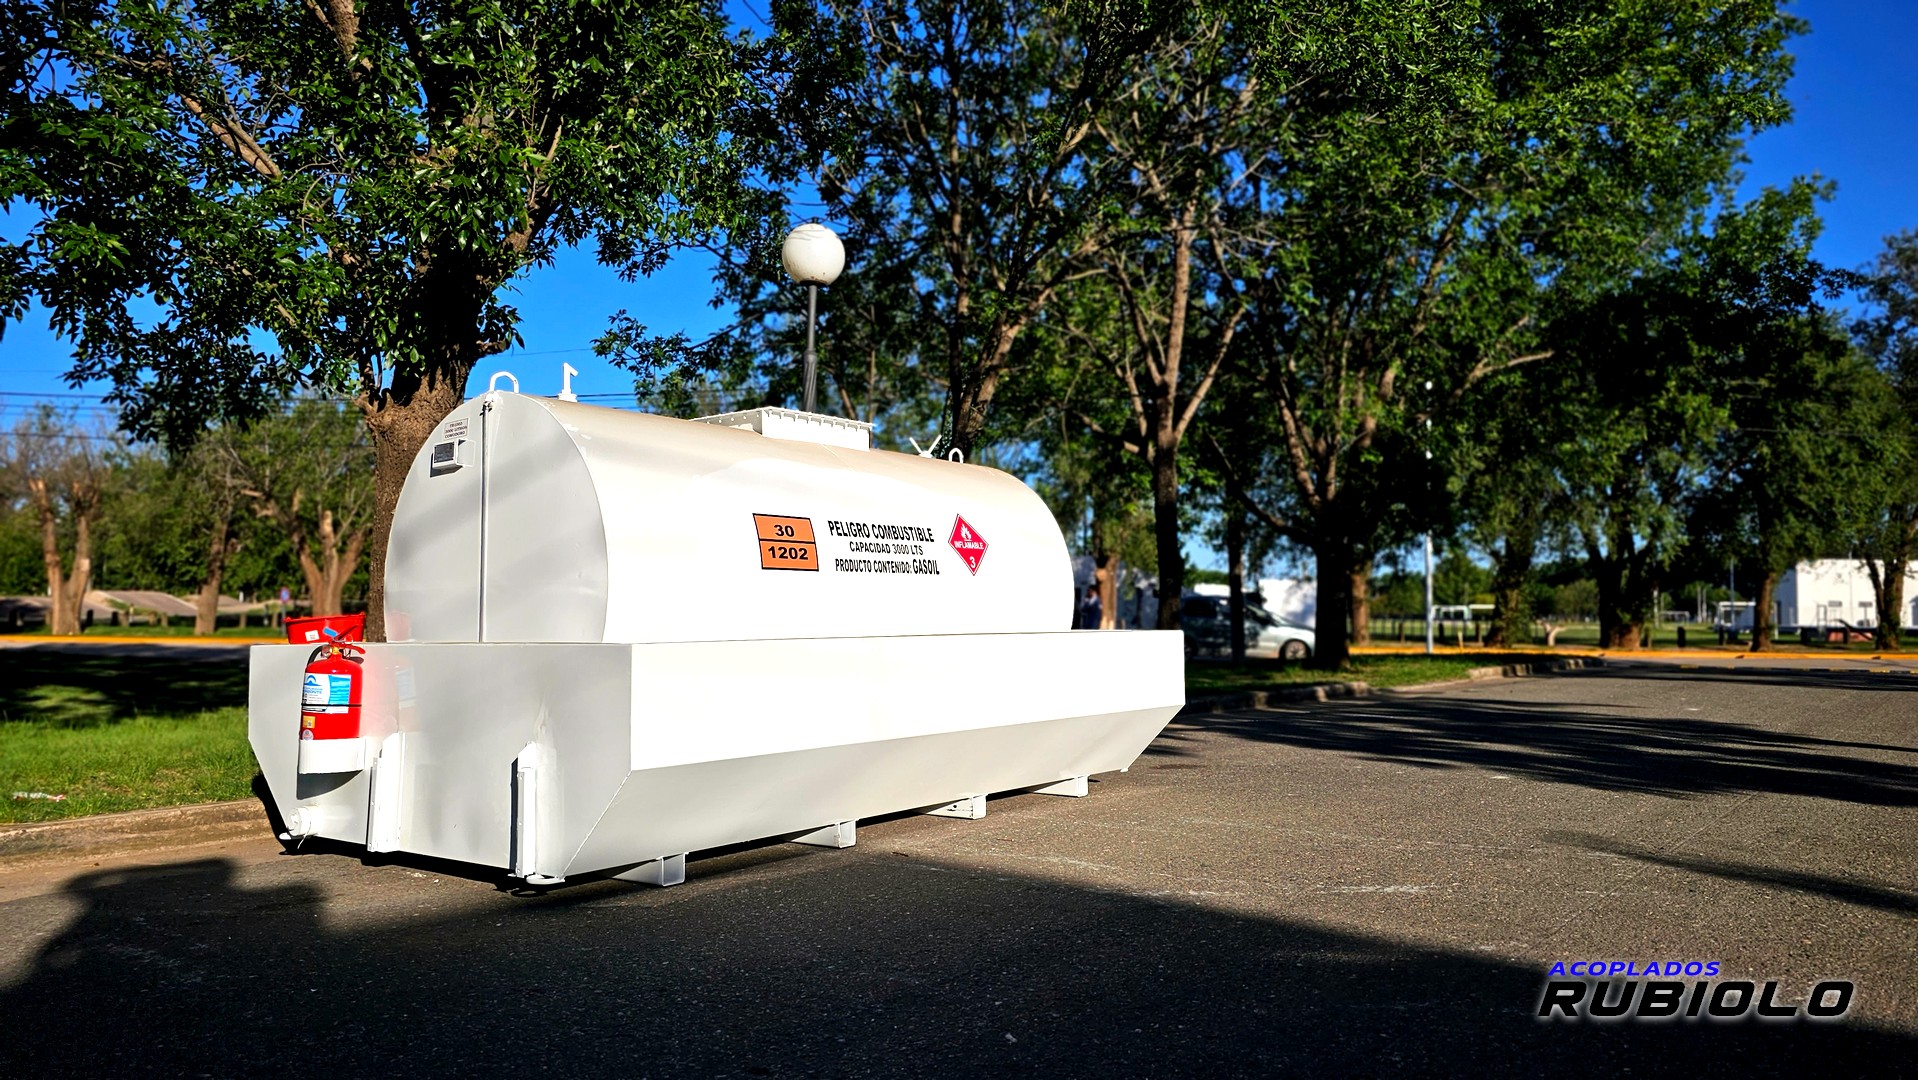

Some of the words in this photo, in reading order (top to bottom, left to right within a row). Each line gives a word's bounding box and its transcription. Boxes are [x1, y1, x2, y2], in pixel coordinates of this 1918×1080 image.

[773, 524, 795, 537] 30
[827, 520, 871, 539] PELIGRO
[871, 523, 935, 542] COMBUSTIBLE
[768, 545, 809, 560] 1202
[849, 541, 891, 554] CAPACIDAD
[892, 543, 910, 555] 3000
[910, 544, 924, 556] LTS
[835, 558, 872, 573] PRODUCTO
[873, 560, 912, 574] CONTENIDO:
[912, 558, 940, 575] GASOIL
[969, 556, 976, 569] 3
